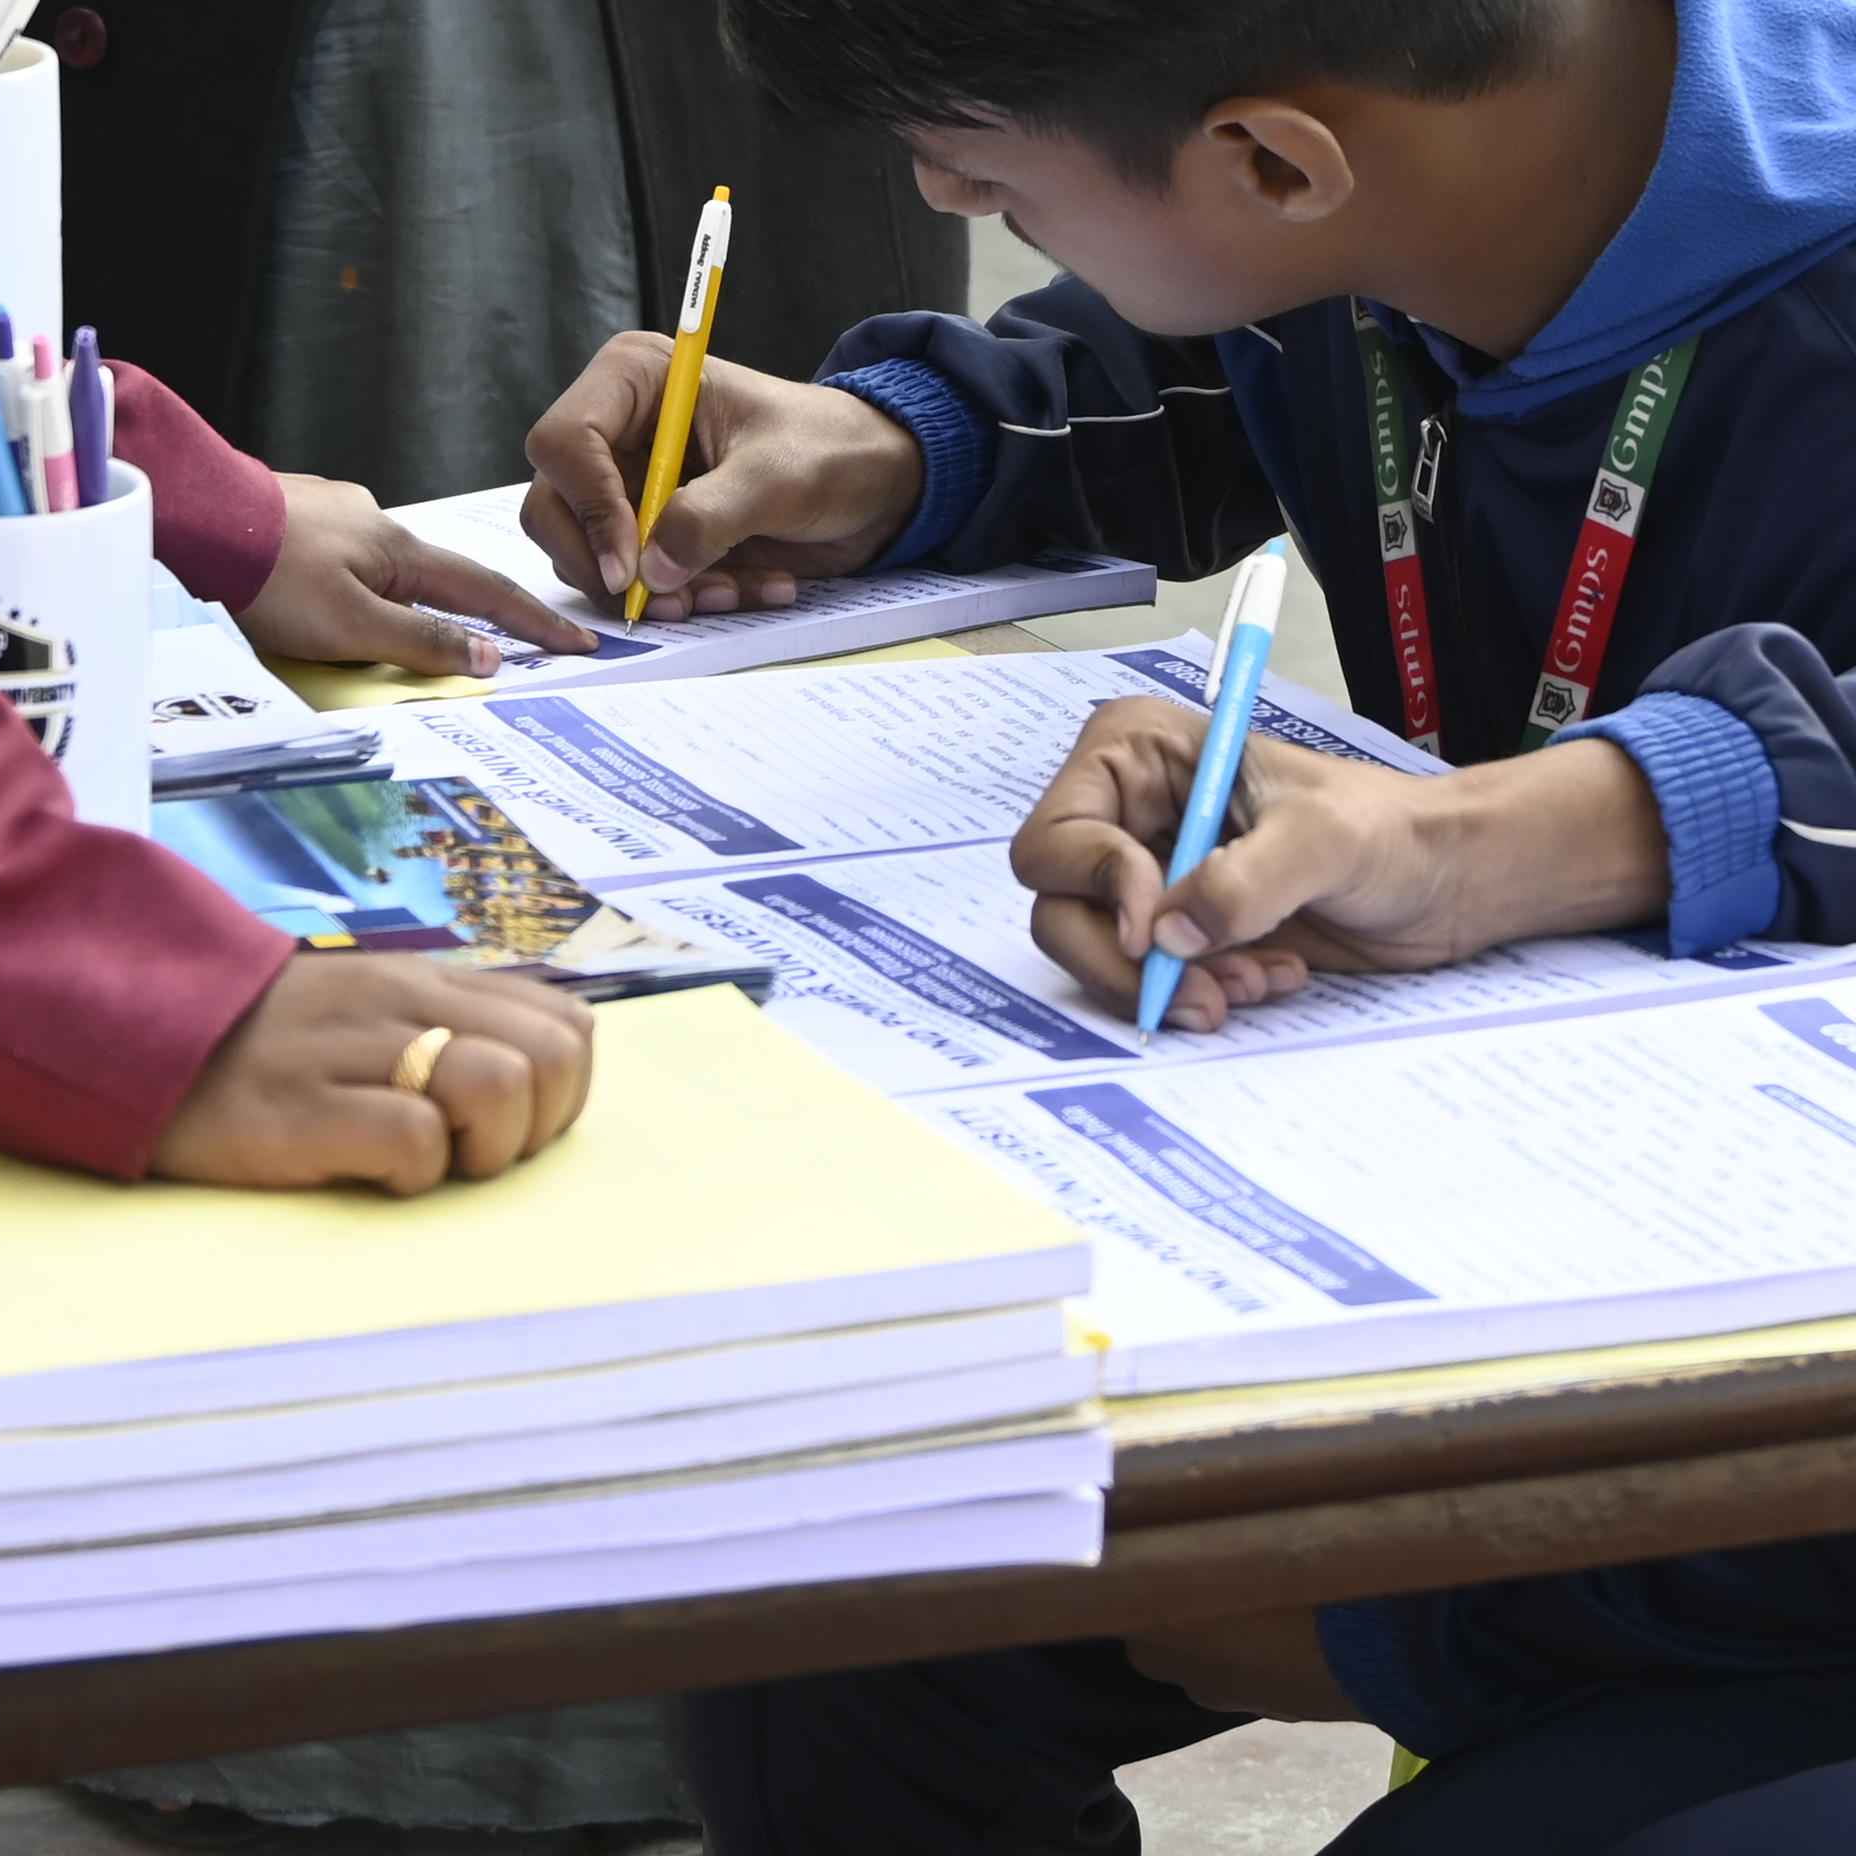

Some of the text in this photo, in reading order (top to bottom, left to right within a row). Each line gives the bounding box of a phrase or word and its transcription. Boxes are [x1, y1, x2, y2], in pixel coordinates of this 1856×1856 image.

[1371, 349, 1400, 498] Gmps
[1610, 344, 1674, 474] Gmps
[1553, 545, 1609, 674] Gmps
[1397, 584, 1429, 730] Gmps
[401, 710, 550, 786] UNIVERSITY
[517, 788, 607, 826] POWER
[582, 824, 665, 860] MIND
[648, 892, 830, 982] UNIVERSITY
[800, 980, 920, 1031] POWER
[898, 1026, 998, 1070] MIND
